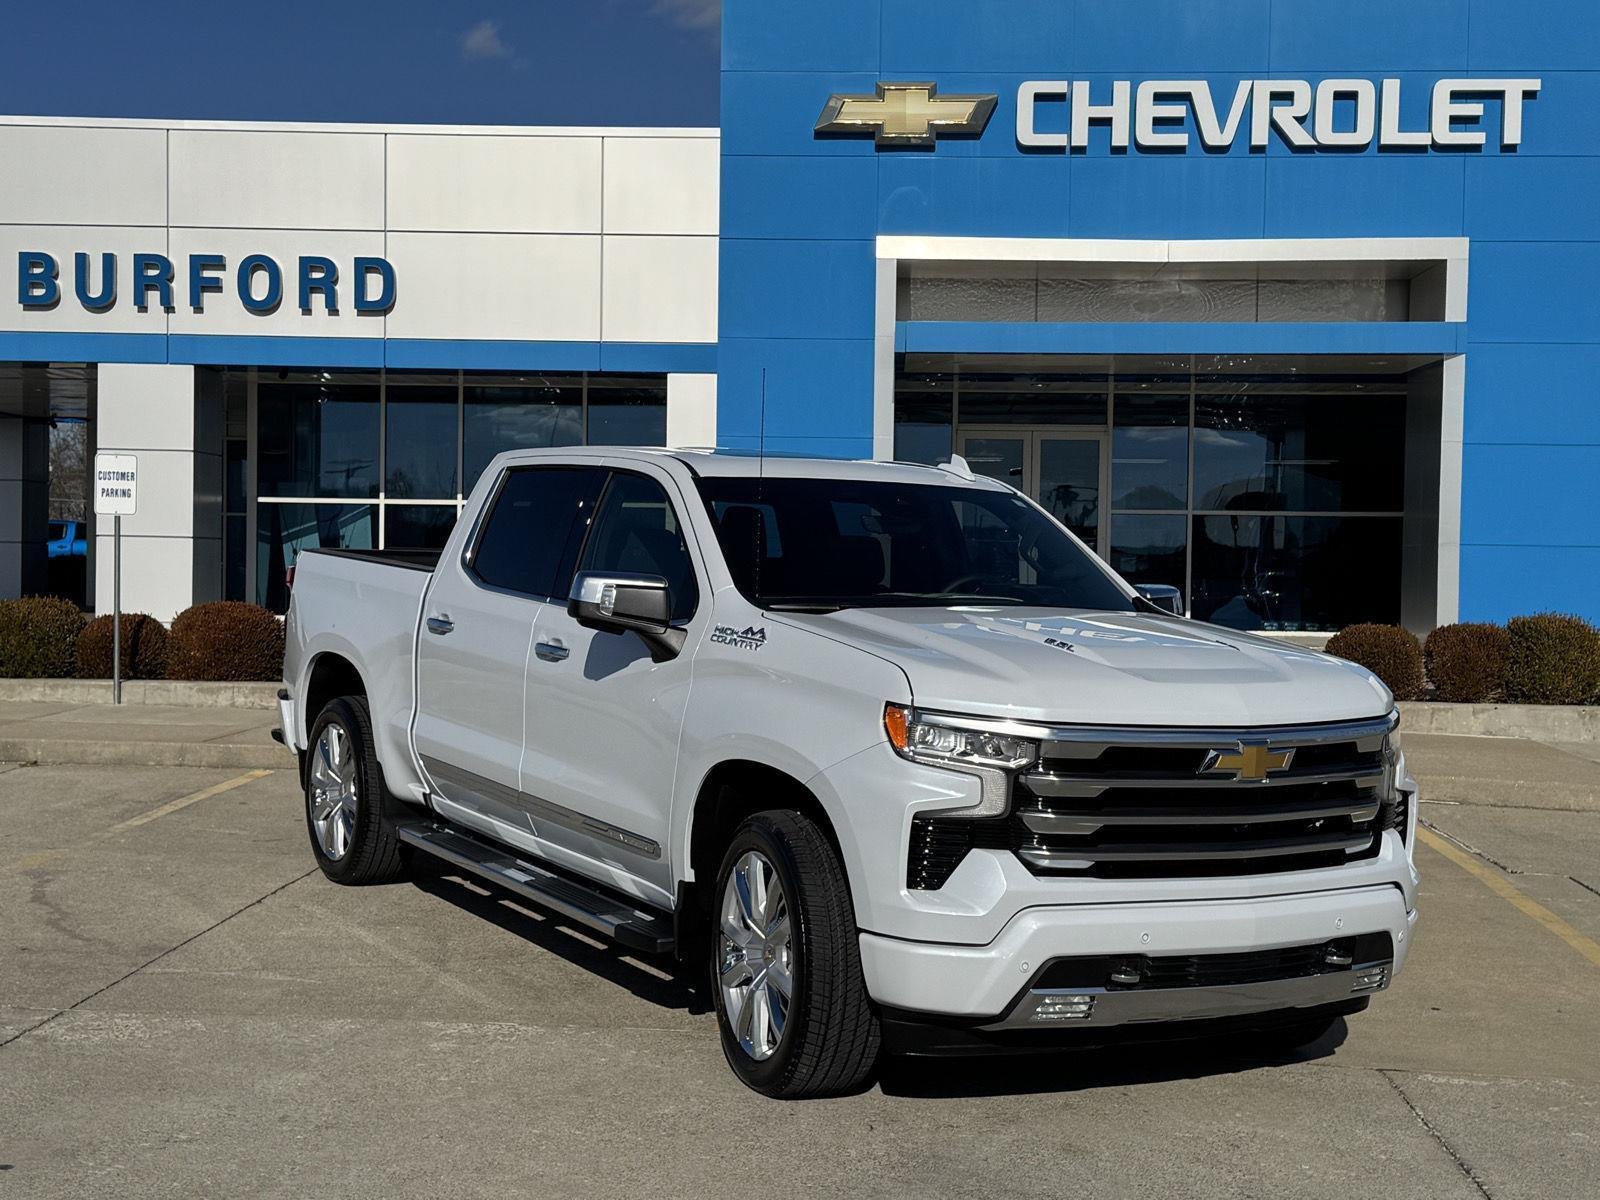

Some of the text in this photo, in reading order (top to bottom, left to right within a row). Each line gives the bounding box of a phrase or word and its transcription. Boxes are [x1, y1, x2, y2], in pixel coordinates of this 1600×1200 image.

[1016, 78, 1541, 148] CHEVROLET
[18, 251, 398, 312] BURFORD
[98, 470, 135, 481] CUSTOMER
[101, 488, 132, 498] PARKING
[710, 633, 763, 651] COUNTRY
